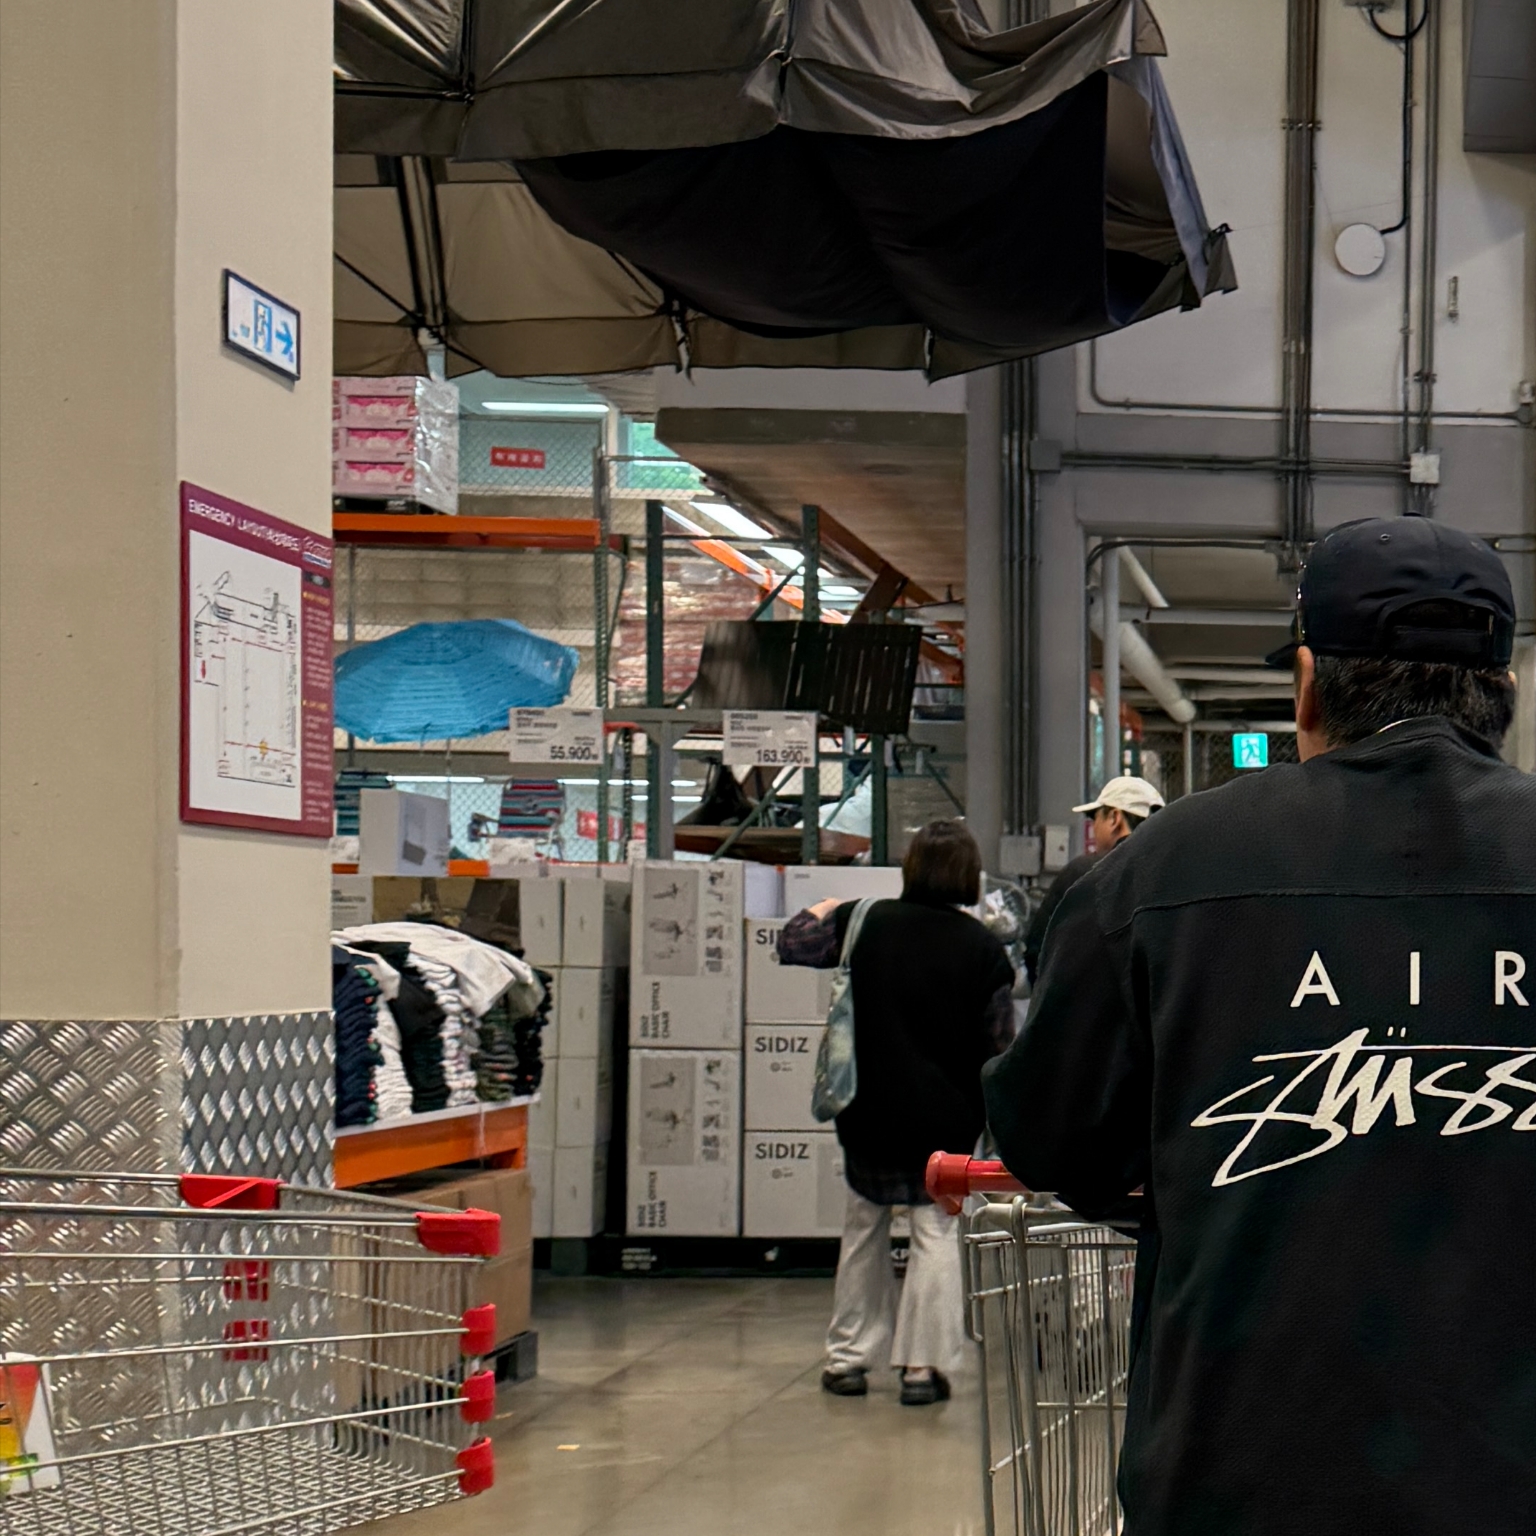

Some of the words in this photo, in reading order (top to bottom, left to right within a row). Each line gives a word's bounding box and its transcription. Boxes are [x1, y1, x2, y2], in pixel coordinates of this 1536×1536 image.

[1290, 950, 1530, 1008] AIR
[755, 1036, 809, 1053] SIDIZ
[755, 1143, 810, 1160] SIDIZ
